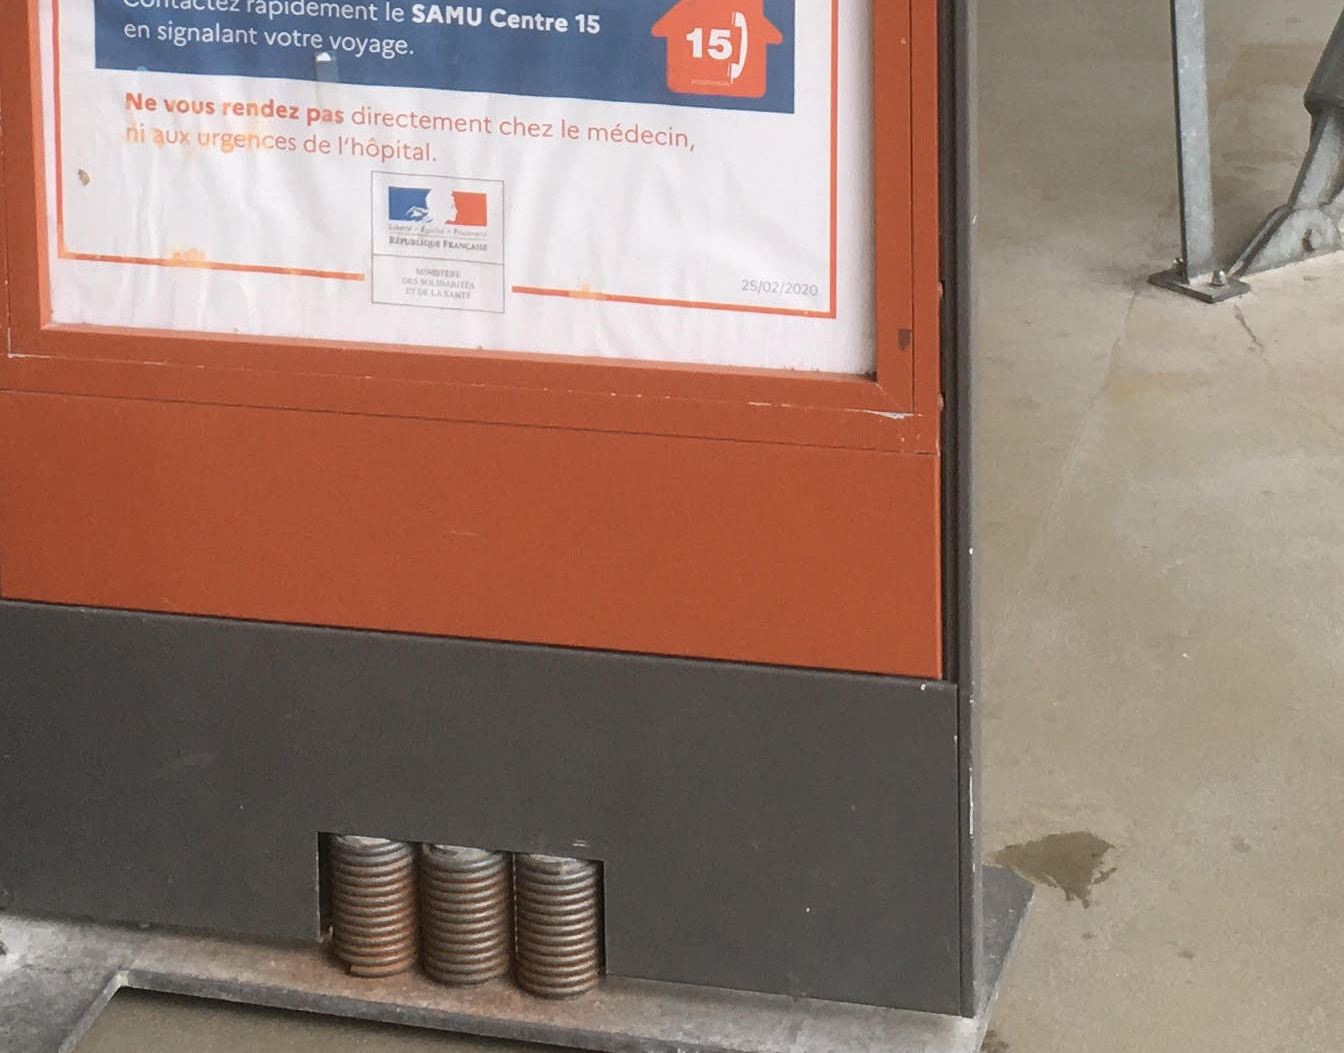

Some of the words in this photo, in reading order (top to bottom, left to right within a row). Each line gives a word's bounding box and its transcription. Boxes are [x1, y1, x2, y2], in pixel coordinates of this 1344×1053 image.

[386, 2, 404, 22] le
[412, 4, 482, 26] SAMU
[490, 9, 568, 32] Centre
[575, 14, 600, 33] 15
[124, 24, 149, 38] en
[158, 20, 257, 46] signalant
[264, 30, 322, 48] votre
[330, 35, 413, 59] voyage.
[687, 28, 732, 59] 15
[126, 93, 157, 111] Ne
[164, 99, 215, 115] vous
[223, 99, 299, 119] rendez
[307, 107, 344, 126] pas
[352, 106, 492, 134] directement
[500, 117, 552, 137] chez
[562, 119, 579, 139] le
[588, 124, 694, 151] médecin,
[126, 123, 145, 143] ni
[154, 129, 190, 148] aux
[198, 132, 296, 153] urgences
[303, 135, 330, 154] de
[742, 279, 818, 296] 25/02/2020
